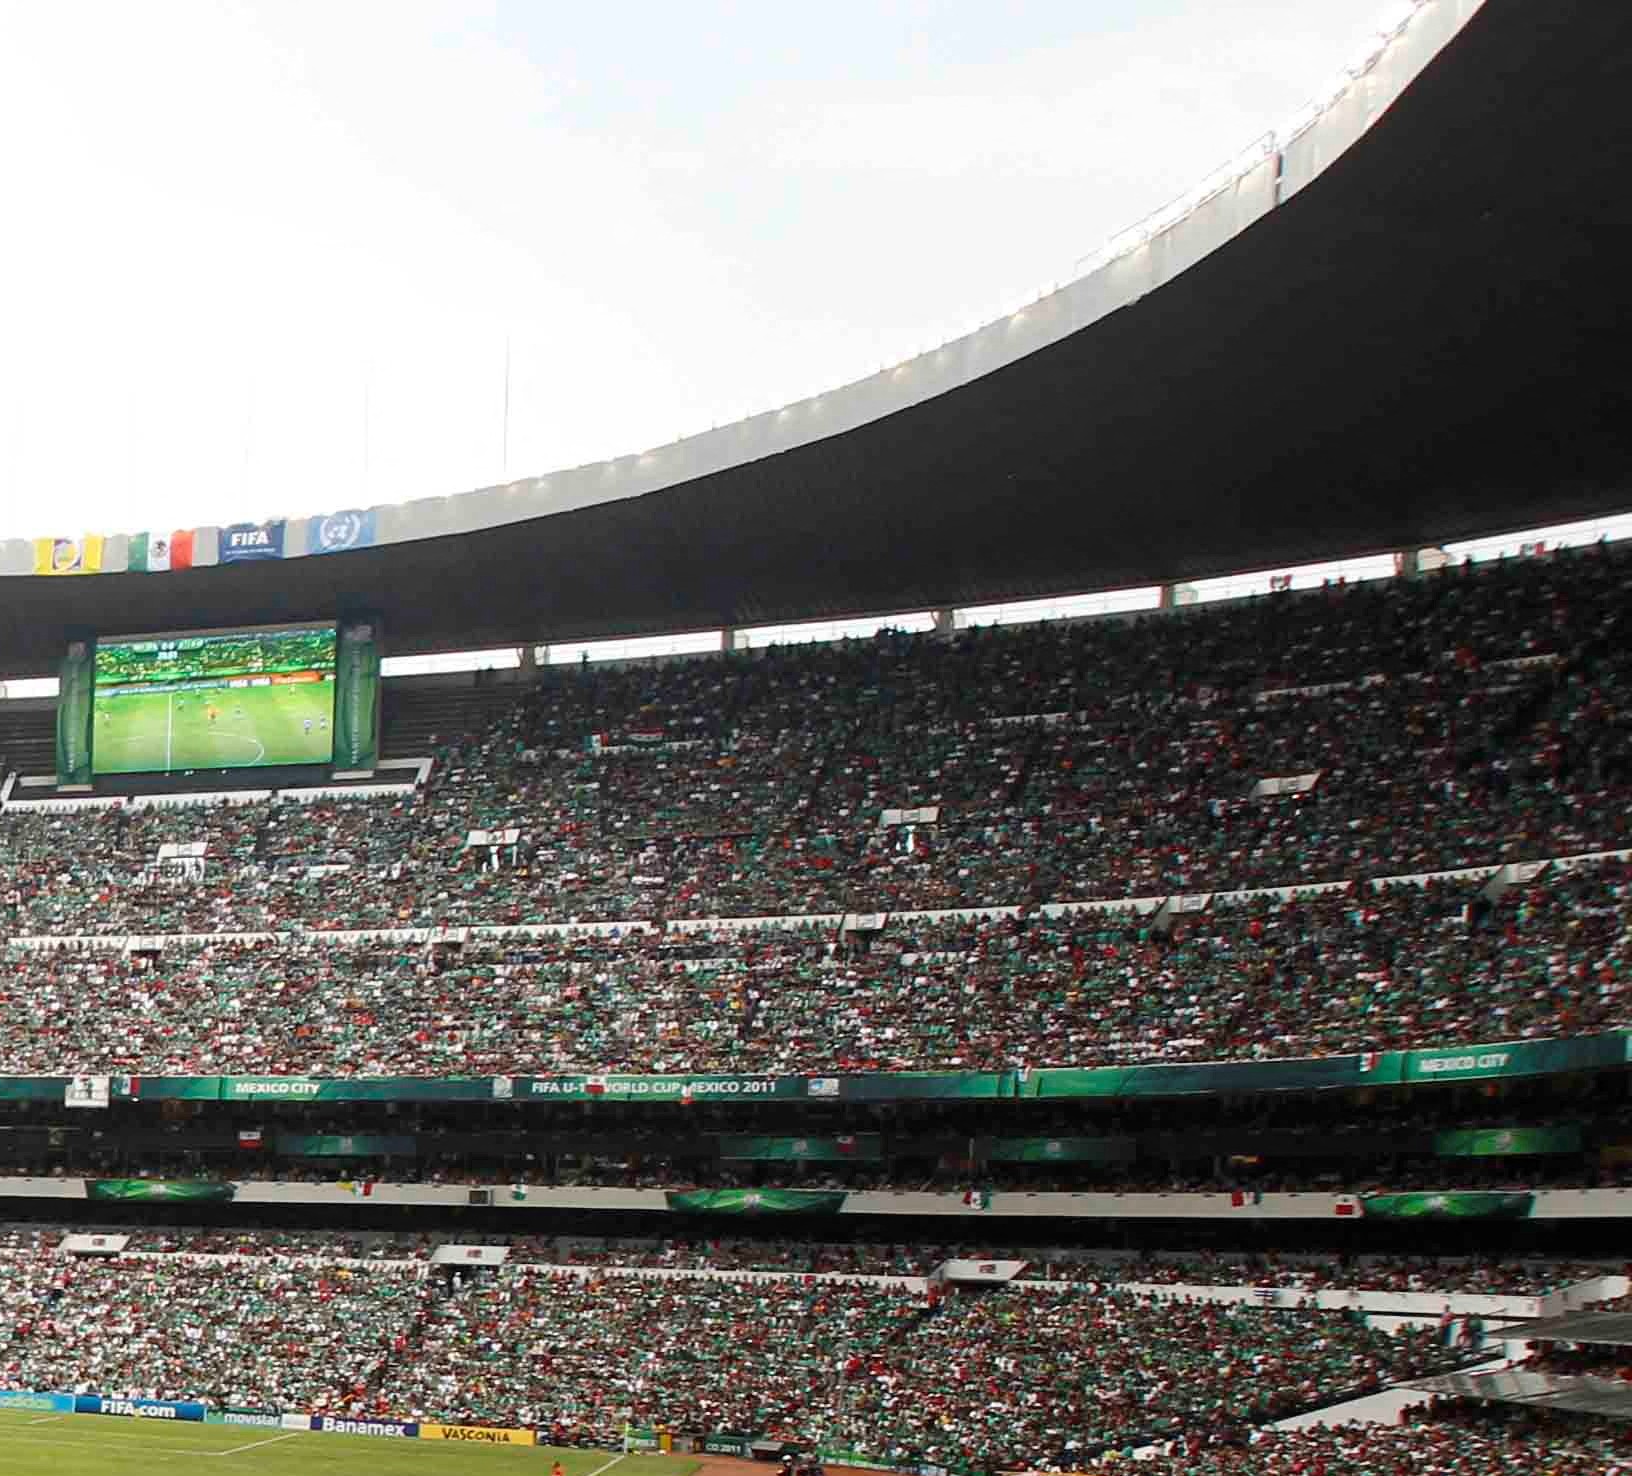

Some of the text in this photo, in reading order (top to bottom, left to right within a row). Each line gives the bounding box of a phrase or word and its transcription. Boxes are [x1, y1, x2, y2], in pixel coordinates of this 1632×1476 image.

[231, 530, 269, 548] FIFA
[1420, 1054, 1509, 1072] MEXICO CITY
[235, 1083, 320, 1094] MEXICO CITY
[532, 1082, 561, 1094] FIFA
[563, 1082, 586, 1093] U-1
[651, 1081, 680, 1093] CUP
[743, 1080, 776, 1092] 2011
[100, 1400, 176, 1418] FIFA.com
[224, 1412, 280, 1426] movistar
[323, 1416, 406, 1437] Banamex
[441, 1427, 511, 1442] VASCONIA
